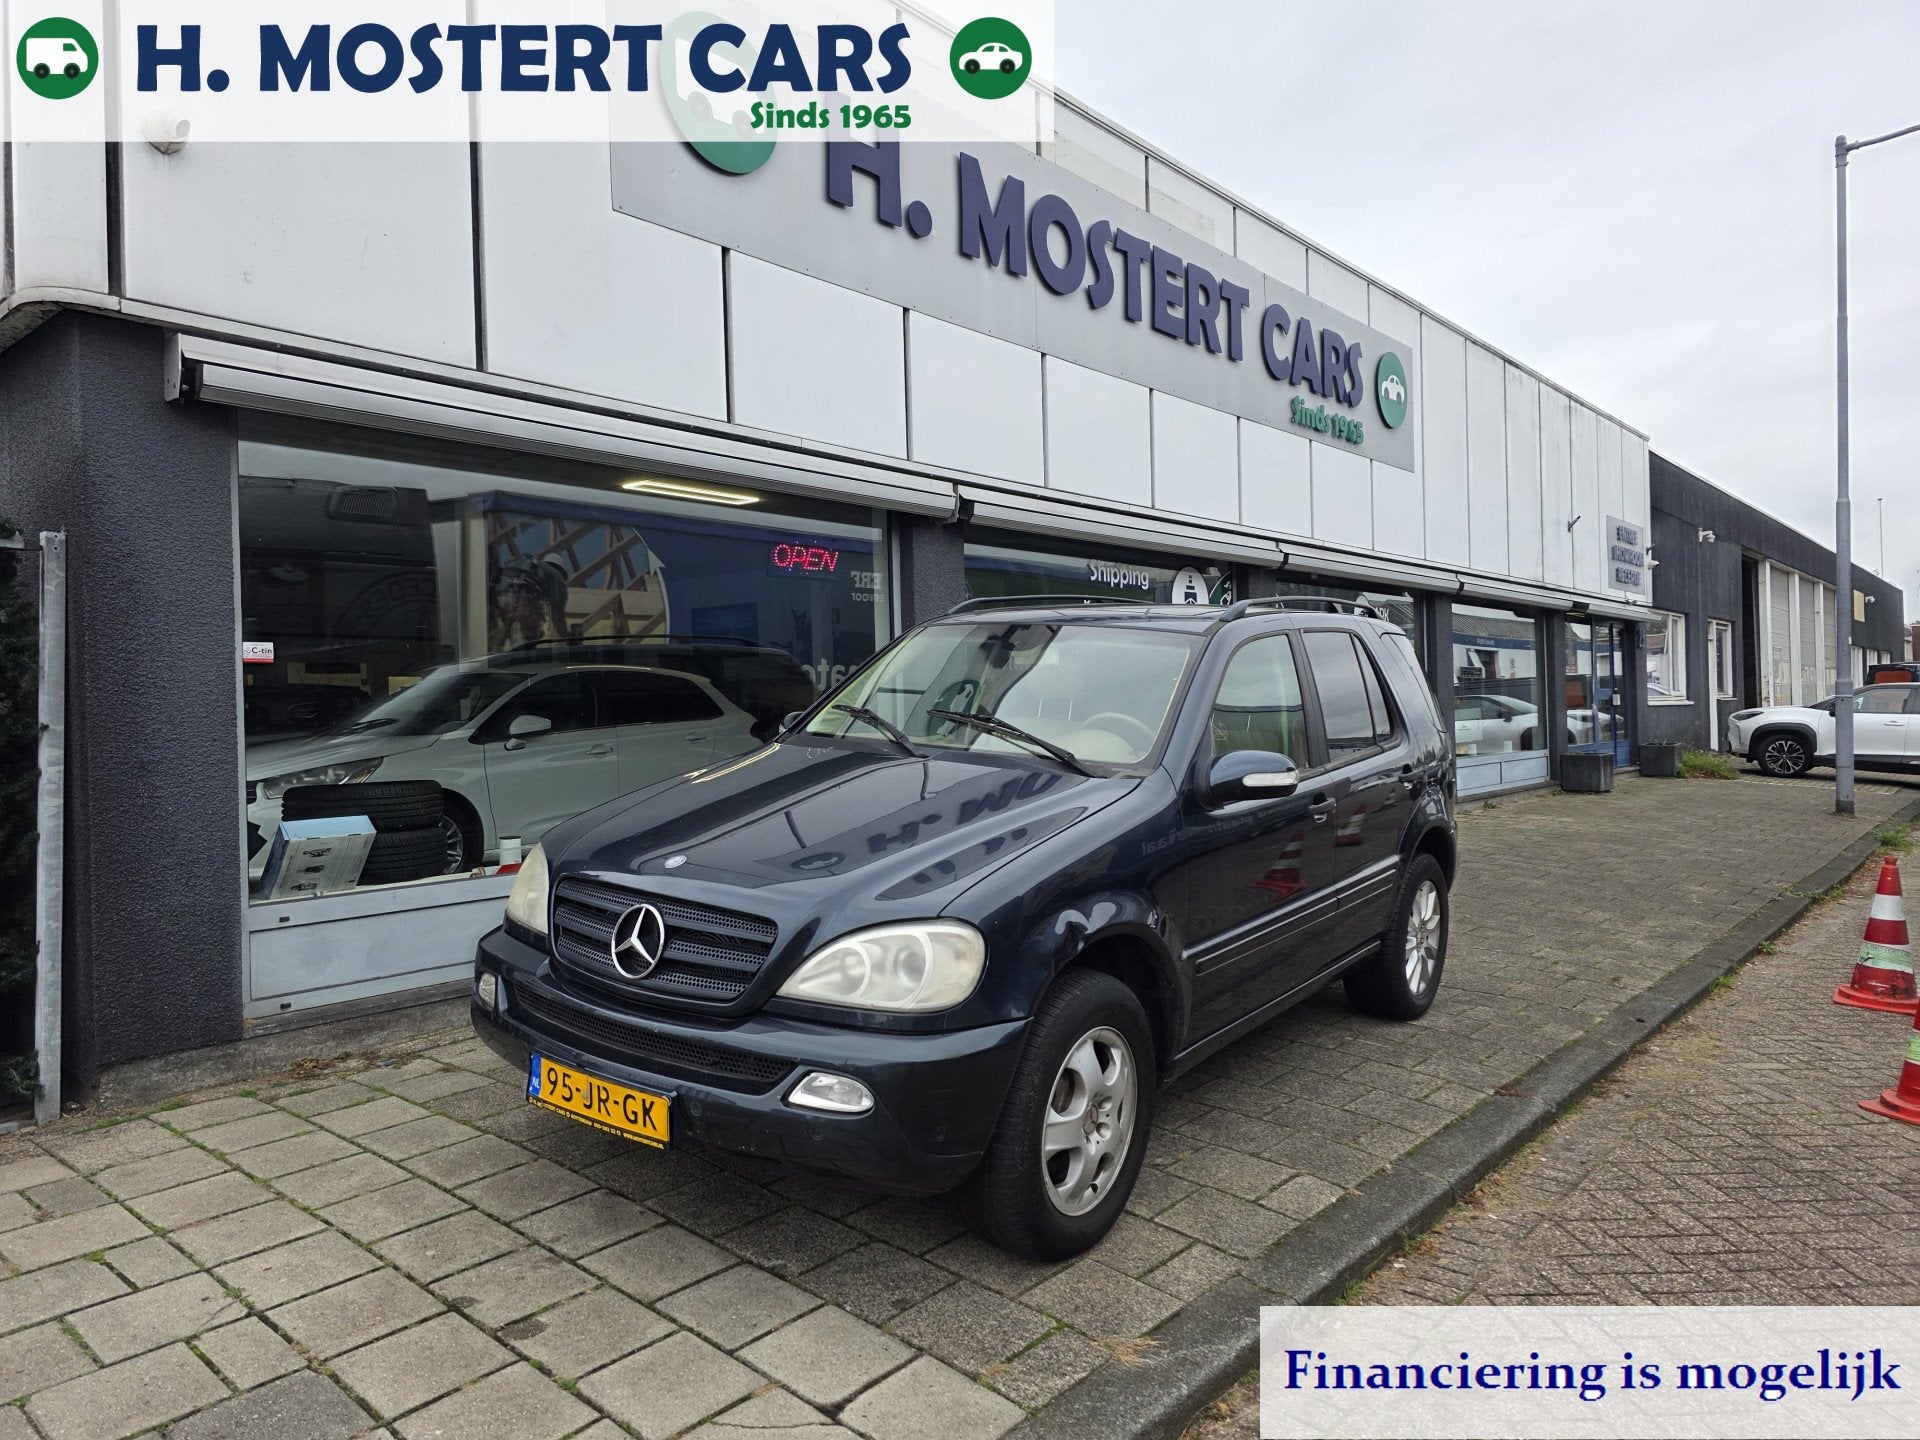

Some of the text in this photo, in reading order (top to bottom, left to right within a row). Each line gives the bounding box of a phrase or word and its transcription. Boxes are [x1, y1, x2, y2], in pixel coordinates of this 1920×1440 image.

[959, 151, 1250, 362] MOSTERT
[1260, 303, 1364, 409] CARS
[1290, 395, 1330, 434] Sinds
[773, 544, 838, 572] OPEN
[1087, 558, 1149, 590] Shipping
[532, 1076, 541, 1088] NL
[546, 1066, 658, 1132] 95-JR-GK
